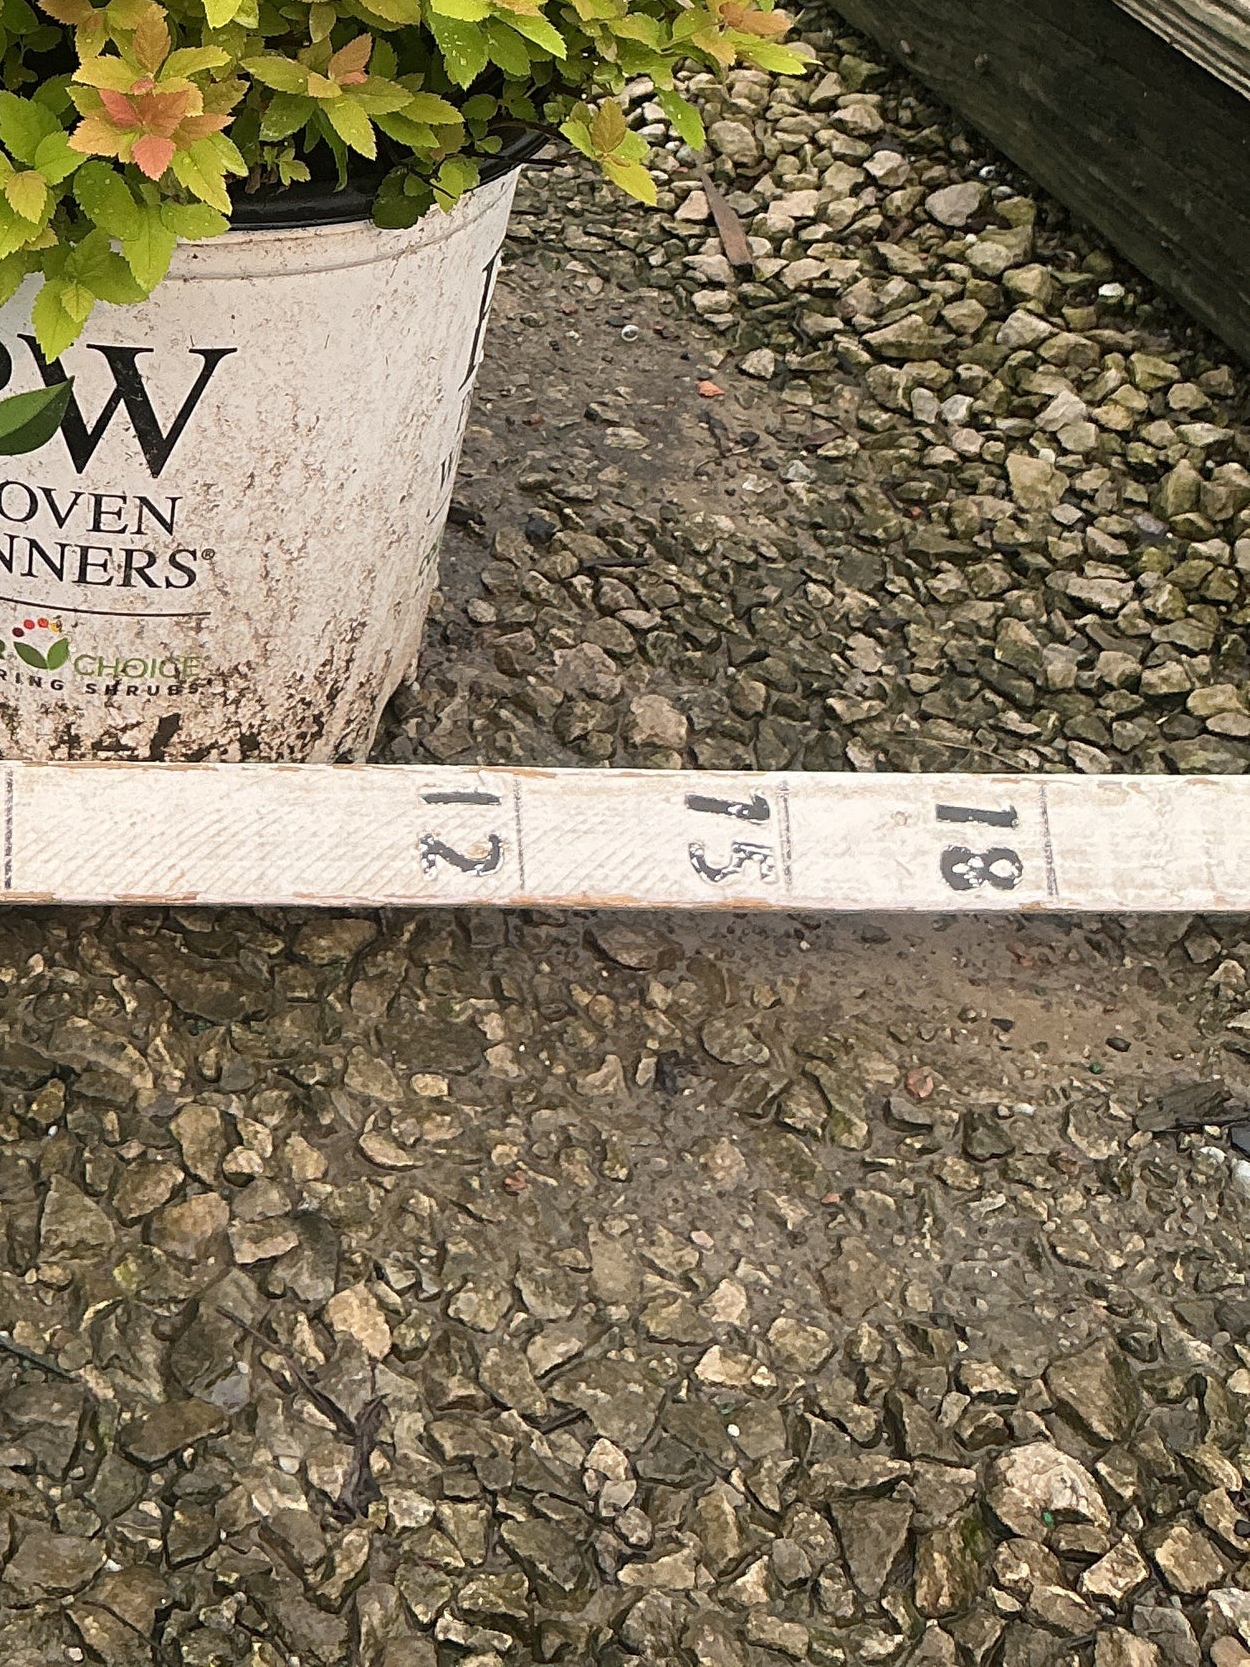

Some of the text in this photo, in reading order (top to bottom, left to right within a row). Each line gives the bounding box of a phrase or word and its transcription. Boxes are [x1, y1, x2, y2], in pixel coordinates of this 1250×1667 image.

[73, 653, 201, 679] CHOICE
[84, 681, 200, 697] SHRUBS
[419, 789, 503, 877] 12
[684, 792, 776, 883] 15
[935, 801, 1025, 891] 18
